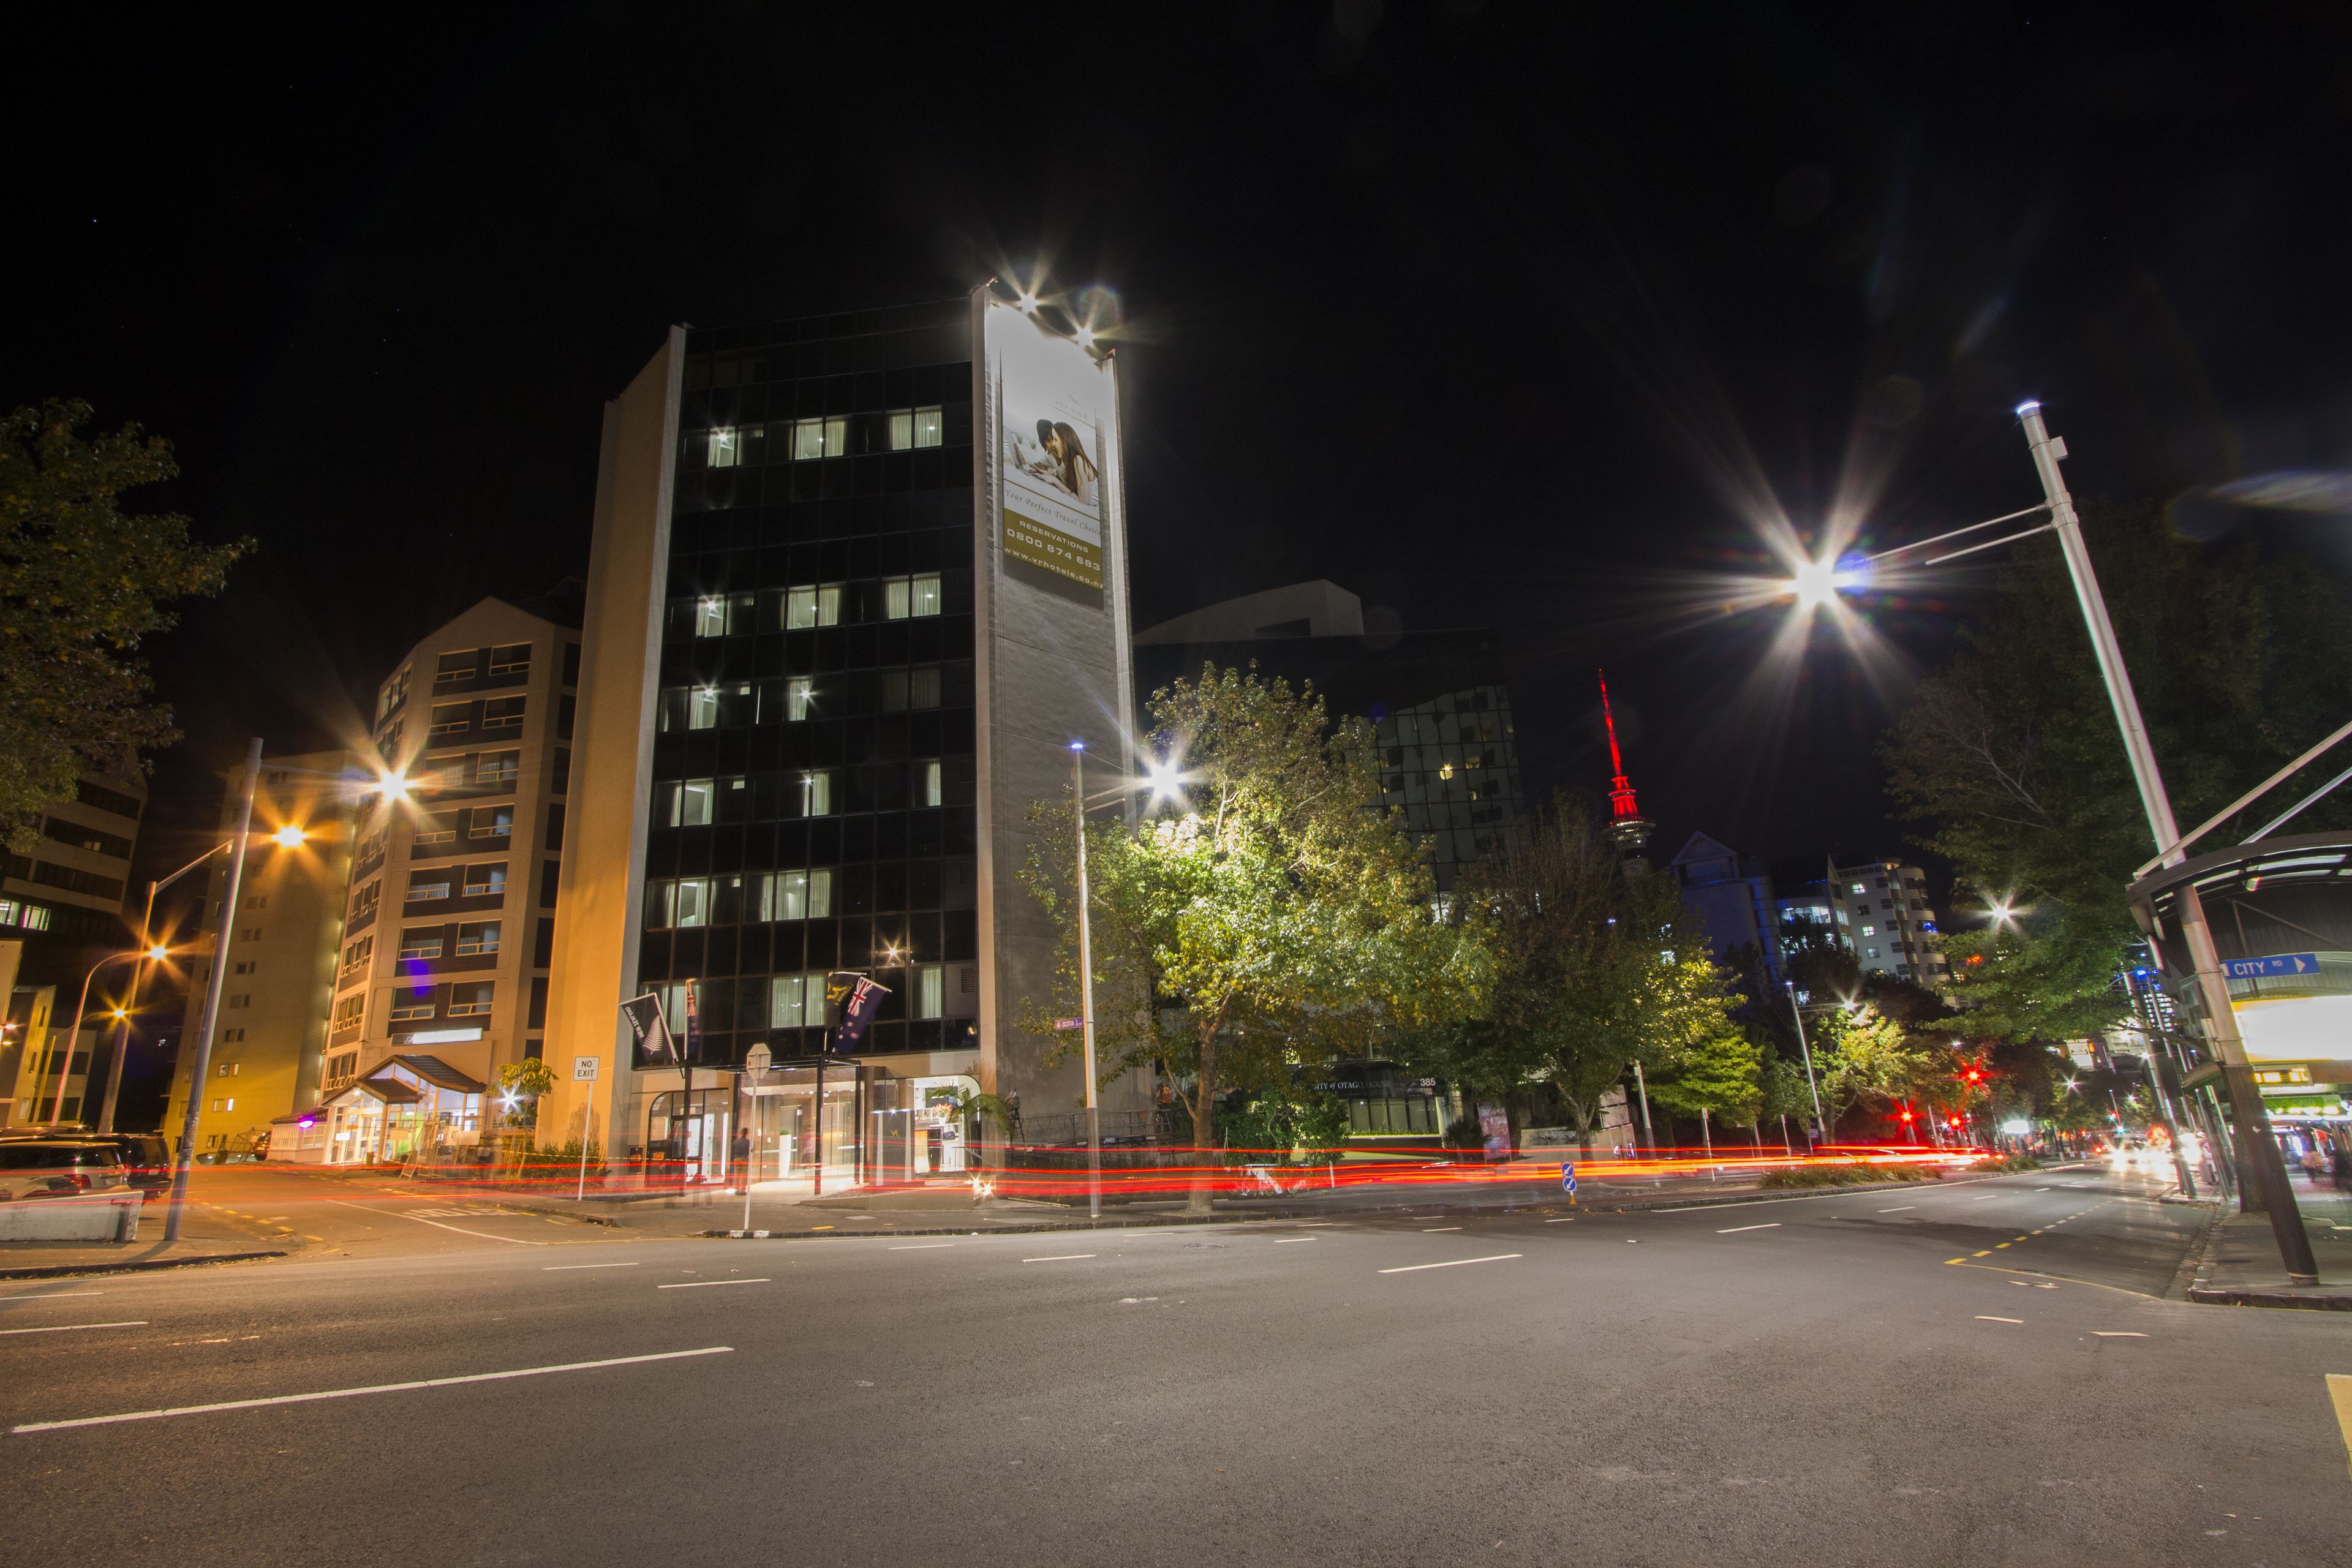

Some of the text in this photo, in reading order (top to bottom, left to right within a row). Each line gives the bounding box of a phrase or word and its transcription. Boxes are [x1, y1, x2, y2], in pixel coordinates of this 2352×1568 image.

[1005, 489, 1101, 537] Your Perfect Travel Choice
[1007, 528, 1100, 571] 0800 874 683
[1019, 521, 1088, 553] RESERVATIONS
[1004, 547, 1104, 589] www.vrhotels.co.nz
[2234, 961, 2264, 975] CITY
[1330, 1082, 1336, 1090] of
[1365, 1080, 1391, 1088] HOUSE
[1420, 1077, 1436, 1087] 385
